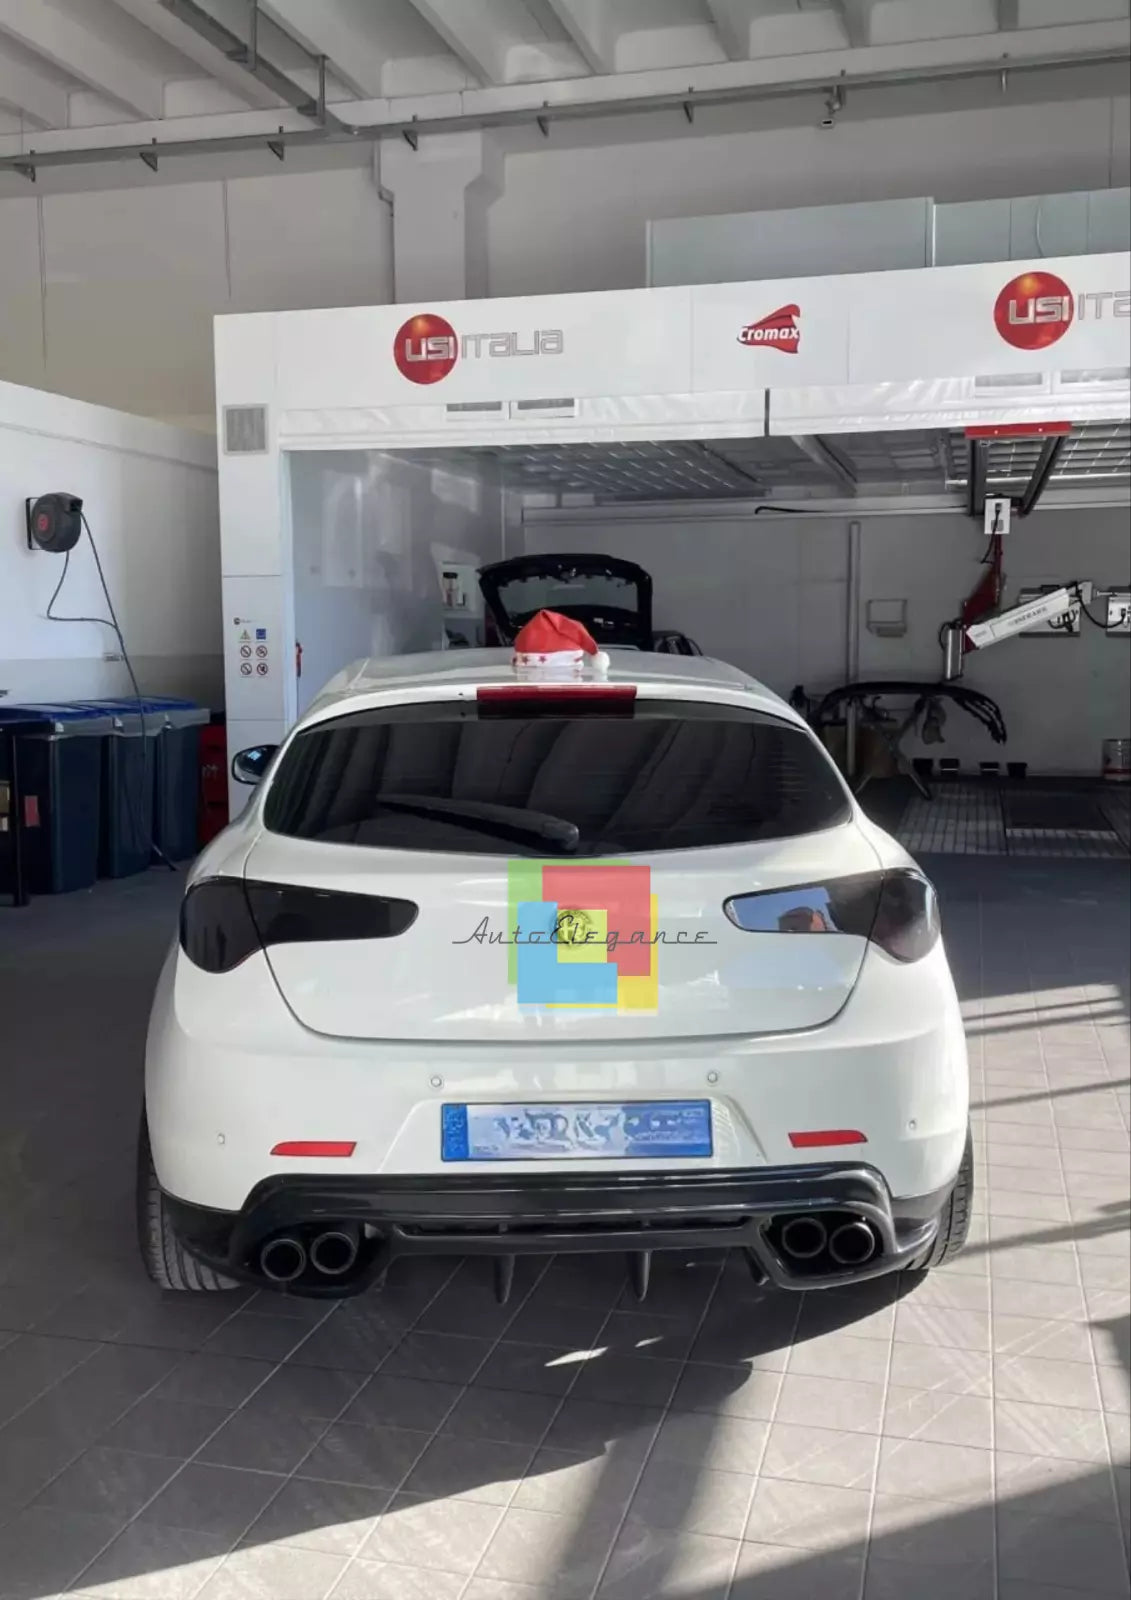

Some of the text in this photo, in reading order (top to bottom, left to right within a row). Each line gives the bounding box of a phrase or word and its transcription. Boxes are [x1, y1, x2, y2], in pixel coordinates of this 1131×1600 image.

[1008, 295, 1070, 325] USI
[738, 327, 799, 341] Cromax
[405, 336, 454, 362] USI
